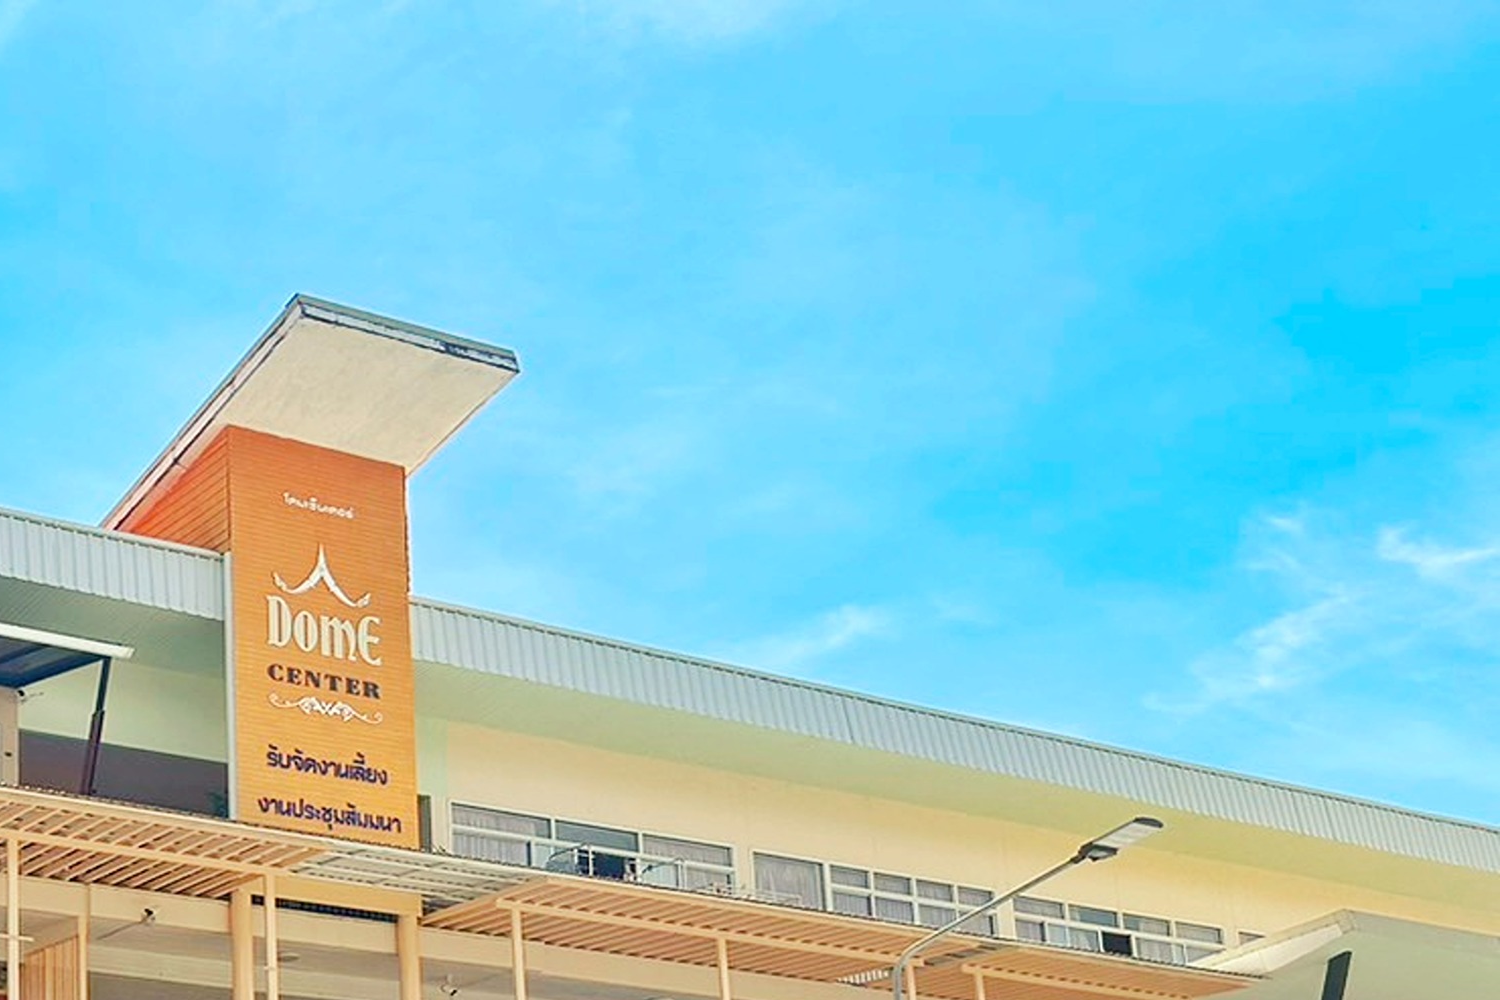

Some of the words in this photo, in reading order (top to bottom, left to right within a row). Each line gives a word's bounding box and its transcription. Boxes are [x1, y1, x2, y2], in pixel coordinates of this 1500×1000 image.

[267, 663, 381, 699] CENTER
[266, 743, 388, 785] รับจัดงานเลี้ยง
[257, 796, 402, 833] งานประชุมสัมมนา
